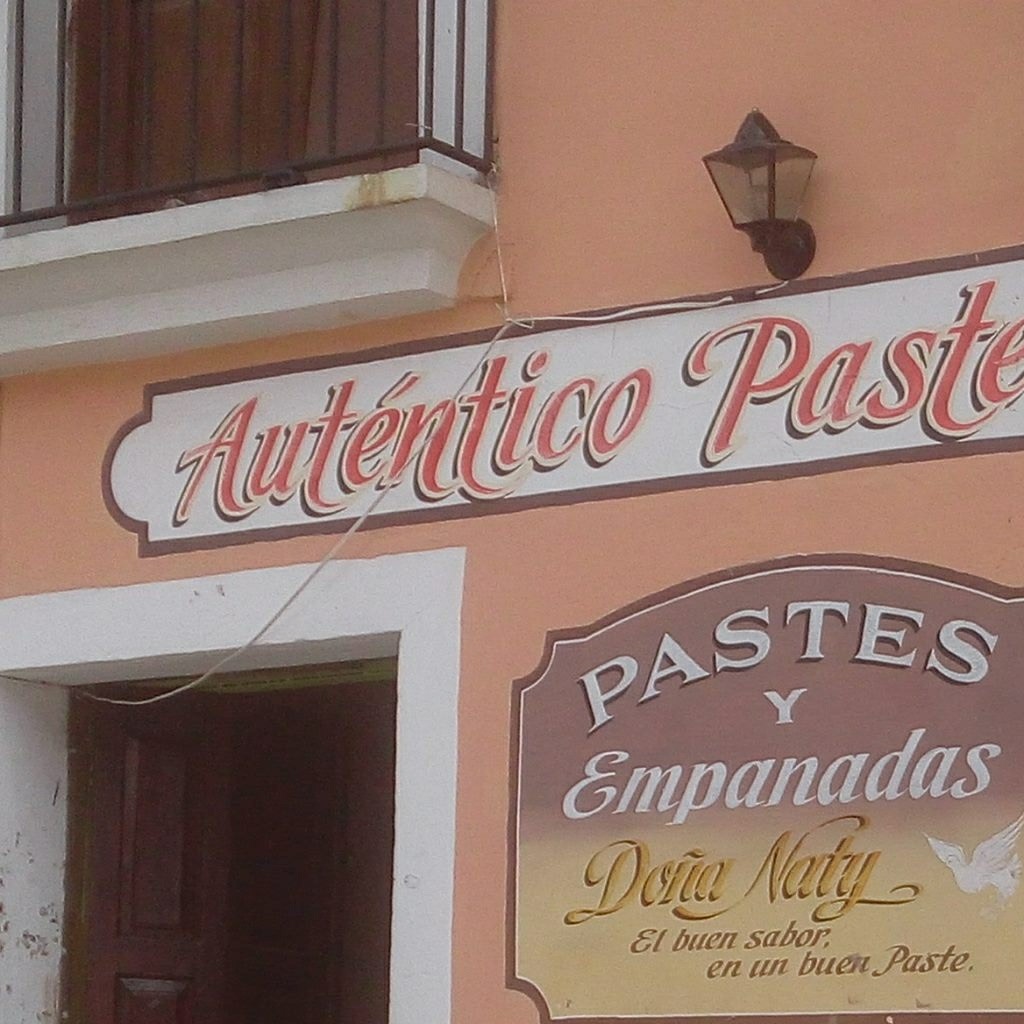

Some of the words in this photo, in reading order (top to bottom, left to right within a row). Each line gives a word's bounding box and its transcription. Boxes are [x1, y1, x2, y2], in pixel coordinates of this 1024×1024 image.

[174, 349, 657, 528] Auténtico
[576, 600, 999, 734] PASTES
[763, 688, 808, 726] Y
[561, 728, 1003, 827] Empanadas
[563, 838, 736, 926] Doña
[742, 814, 926, 924] Naty
[630, 929, 664, 954] El
[672, 927, 736, 952] buen
[744, 921, 832, 951] sabor,
[706, 960, 741, 980] en
[749, 960, 789, 978] un
[799, 953, 871, 977] buen
[873, 945, 976, 978] Paste.
